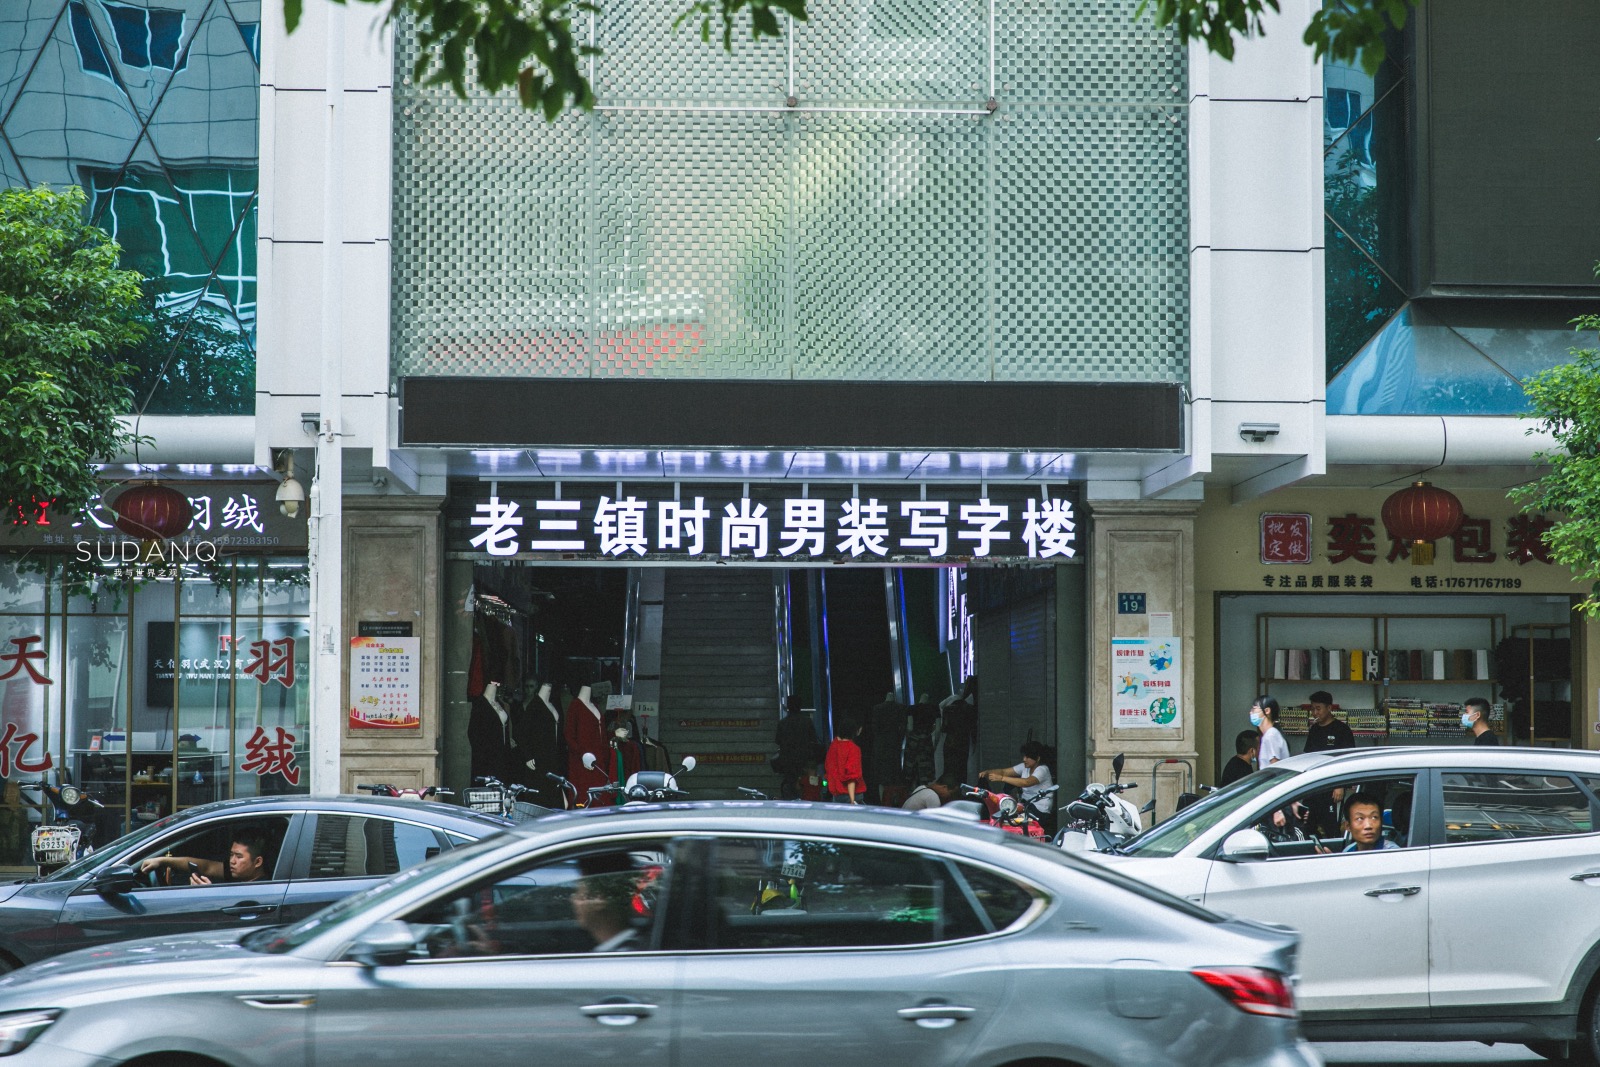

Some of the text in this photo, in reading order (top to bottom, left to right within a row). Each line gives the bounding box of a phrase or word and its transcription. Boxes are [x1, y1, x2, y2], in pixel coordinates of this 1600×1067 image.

[469, 496, 1076, 558] 老三镇时尚男装写字楼
[1268, 520, 1303, 537] 批发
[1268, 540, 1306, 557] 定做
[1263, 575, 1373, 588] 专注品质服装袋
[1123, 601, 1138, 611] 19
